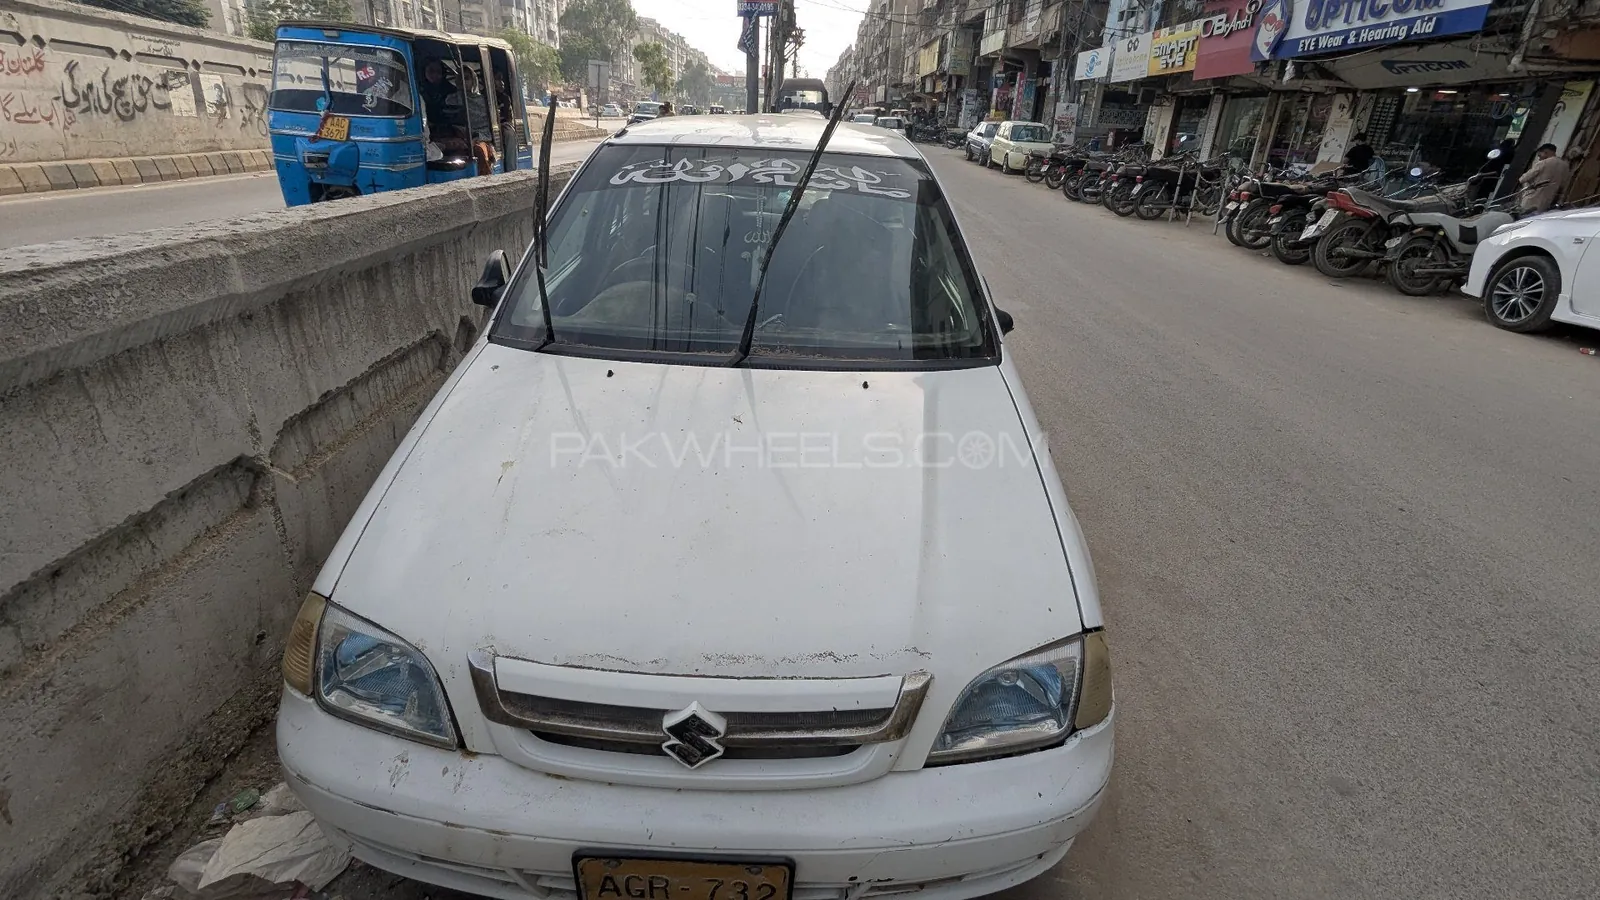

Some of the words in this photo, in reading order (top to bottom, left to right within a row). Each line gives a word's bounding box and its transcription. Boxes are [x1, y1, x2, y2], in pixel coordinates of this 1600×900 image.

[1298, 38, 1316, 52] EYE
[1318, 35, 1344, 49] Wear
[1347, 30, 1358, 44] &
[1359, 22, 1407, 43] Hearing
[1411, 17, 1436, 35] Aid
[1382, 60, 1471, 75] OPTICOM
[330, 117, 346, 129] AAC
